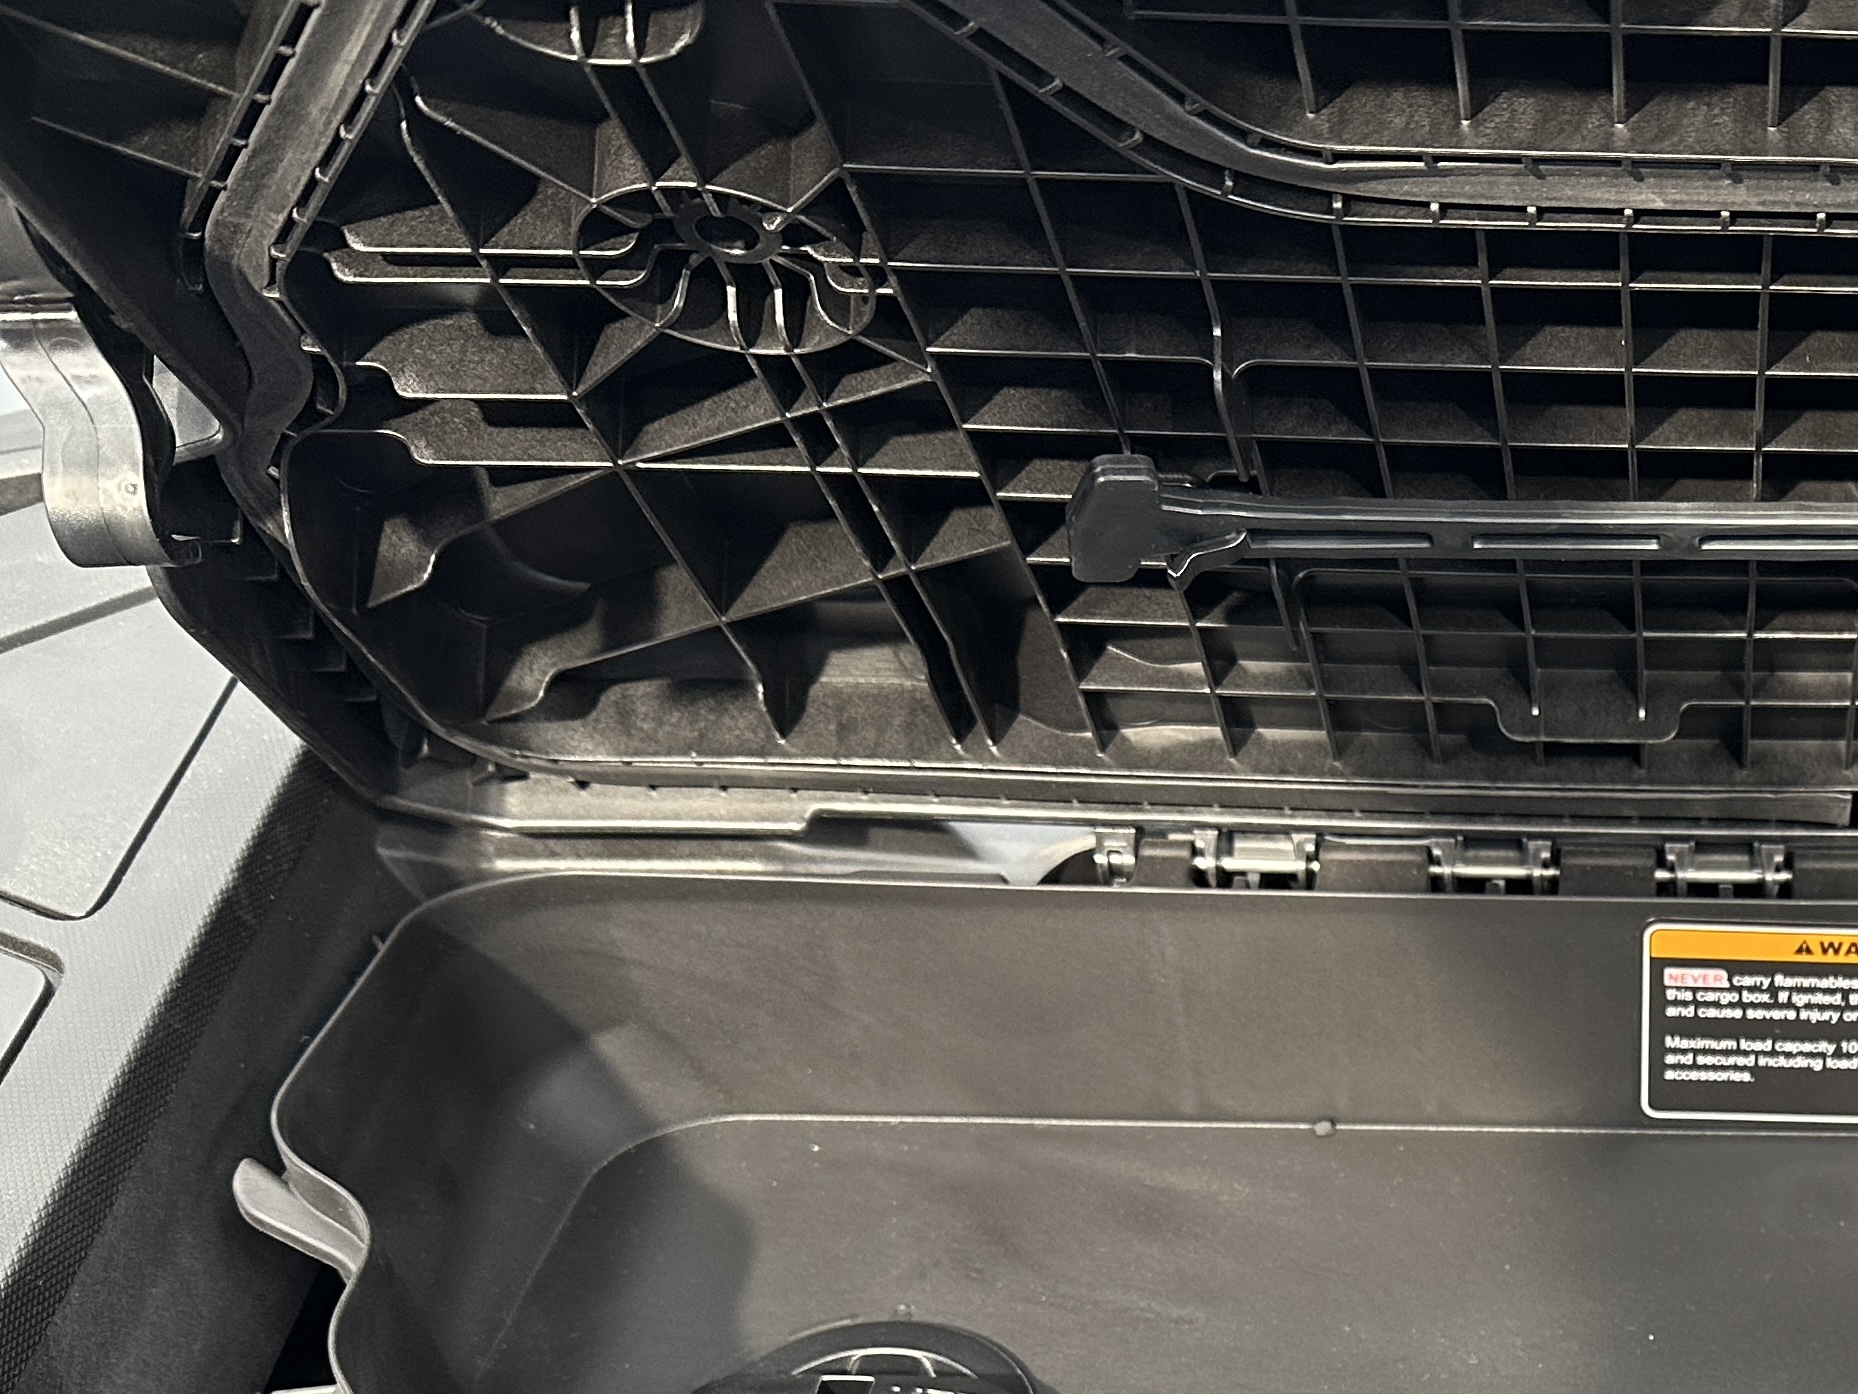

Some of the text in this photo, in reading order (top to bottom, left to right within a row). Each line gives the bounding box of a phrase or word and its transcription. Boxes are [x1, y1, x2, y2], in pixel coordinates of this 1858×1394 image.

[1667, 972, 1726, 986] NEVER
[1732, 975, 1771, 990] carry
[1774, 973, 1858, 990] flammables
[1665, 988, 1693, 1001] this
[1696, 990, 1739, 1004] cargo
[1742, 989, 1774, 1003] box.
[1778, 990, 1789, 1003] If
[1792, 991, 1846, 1007] ignited,
[1665, 1004, 1694, 1018] and
[1697, 1006, 1743, 1019] cause
[1746, 1008, 1797, 1020] severe
[1800, 1008, 1840, 1024] injury
[1664, 1034, 1737, 1050] Maximum
[1739, 1037, 1772, 1051] load
[1774, 1039, 1836, 1055] capacity
[1841, 1040, 1858, 1054] 10
[1664, 1052, 1693, 1065] and
[1696, 1054, 1755, 1066] secured
[1758, 1055, 1823, 1071] including
[1825, 1056, 1858, 1069] load
[1664, 1069, 1755, 1082] accessories.
